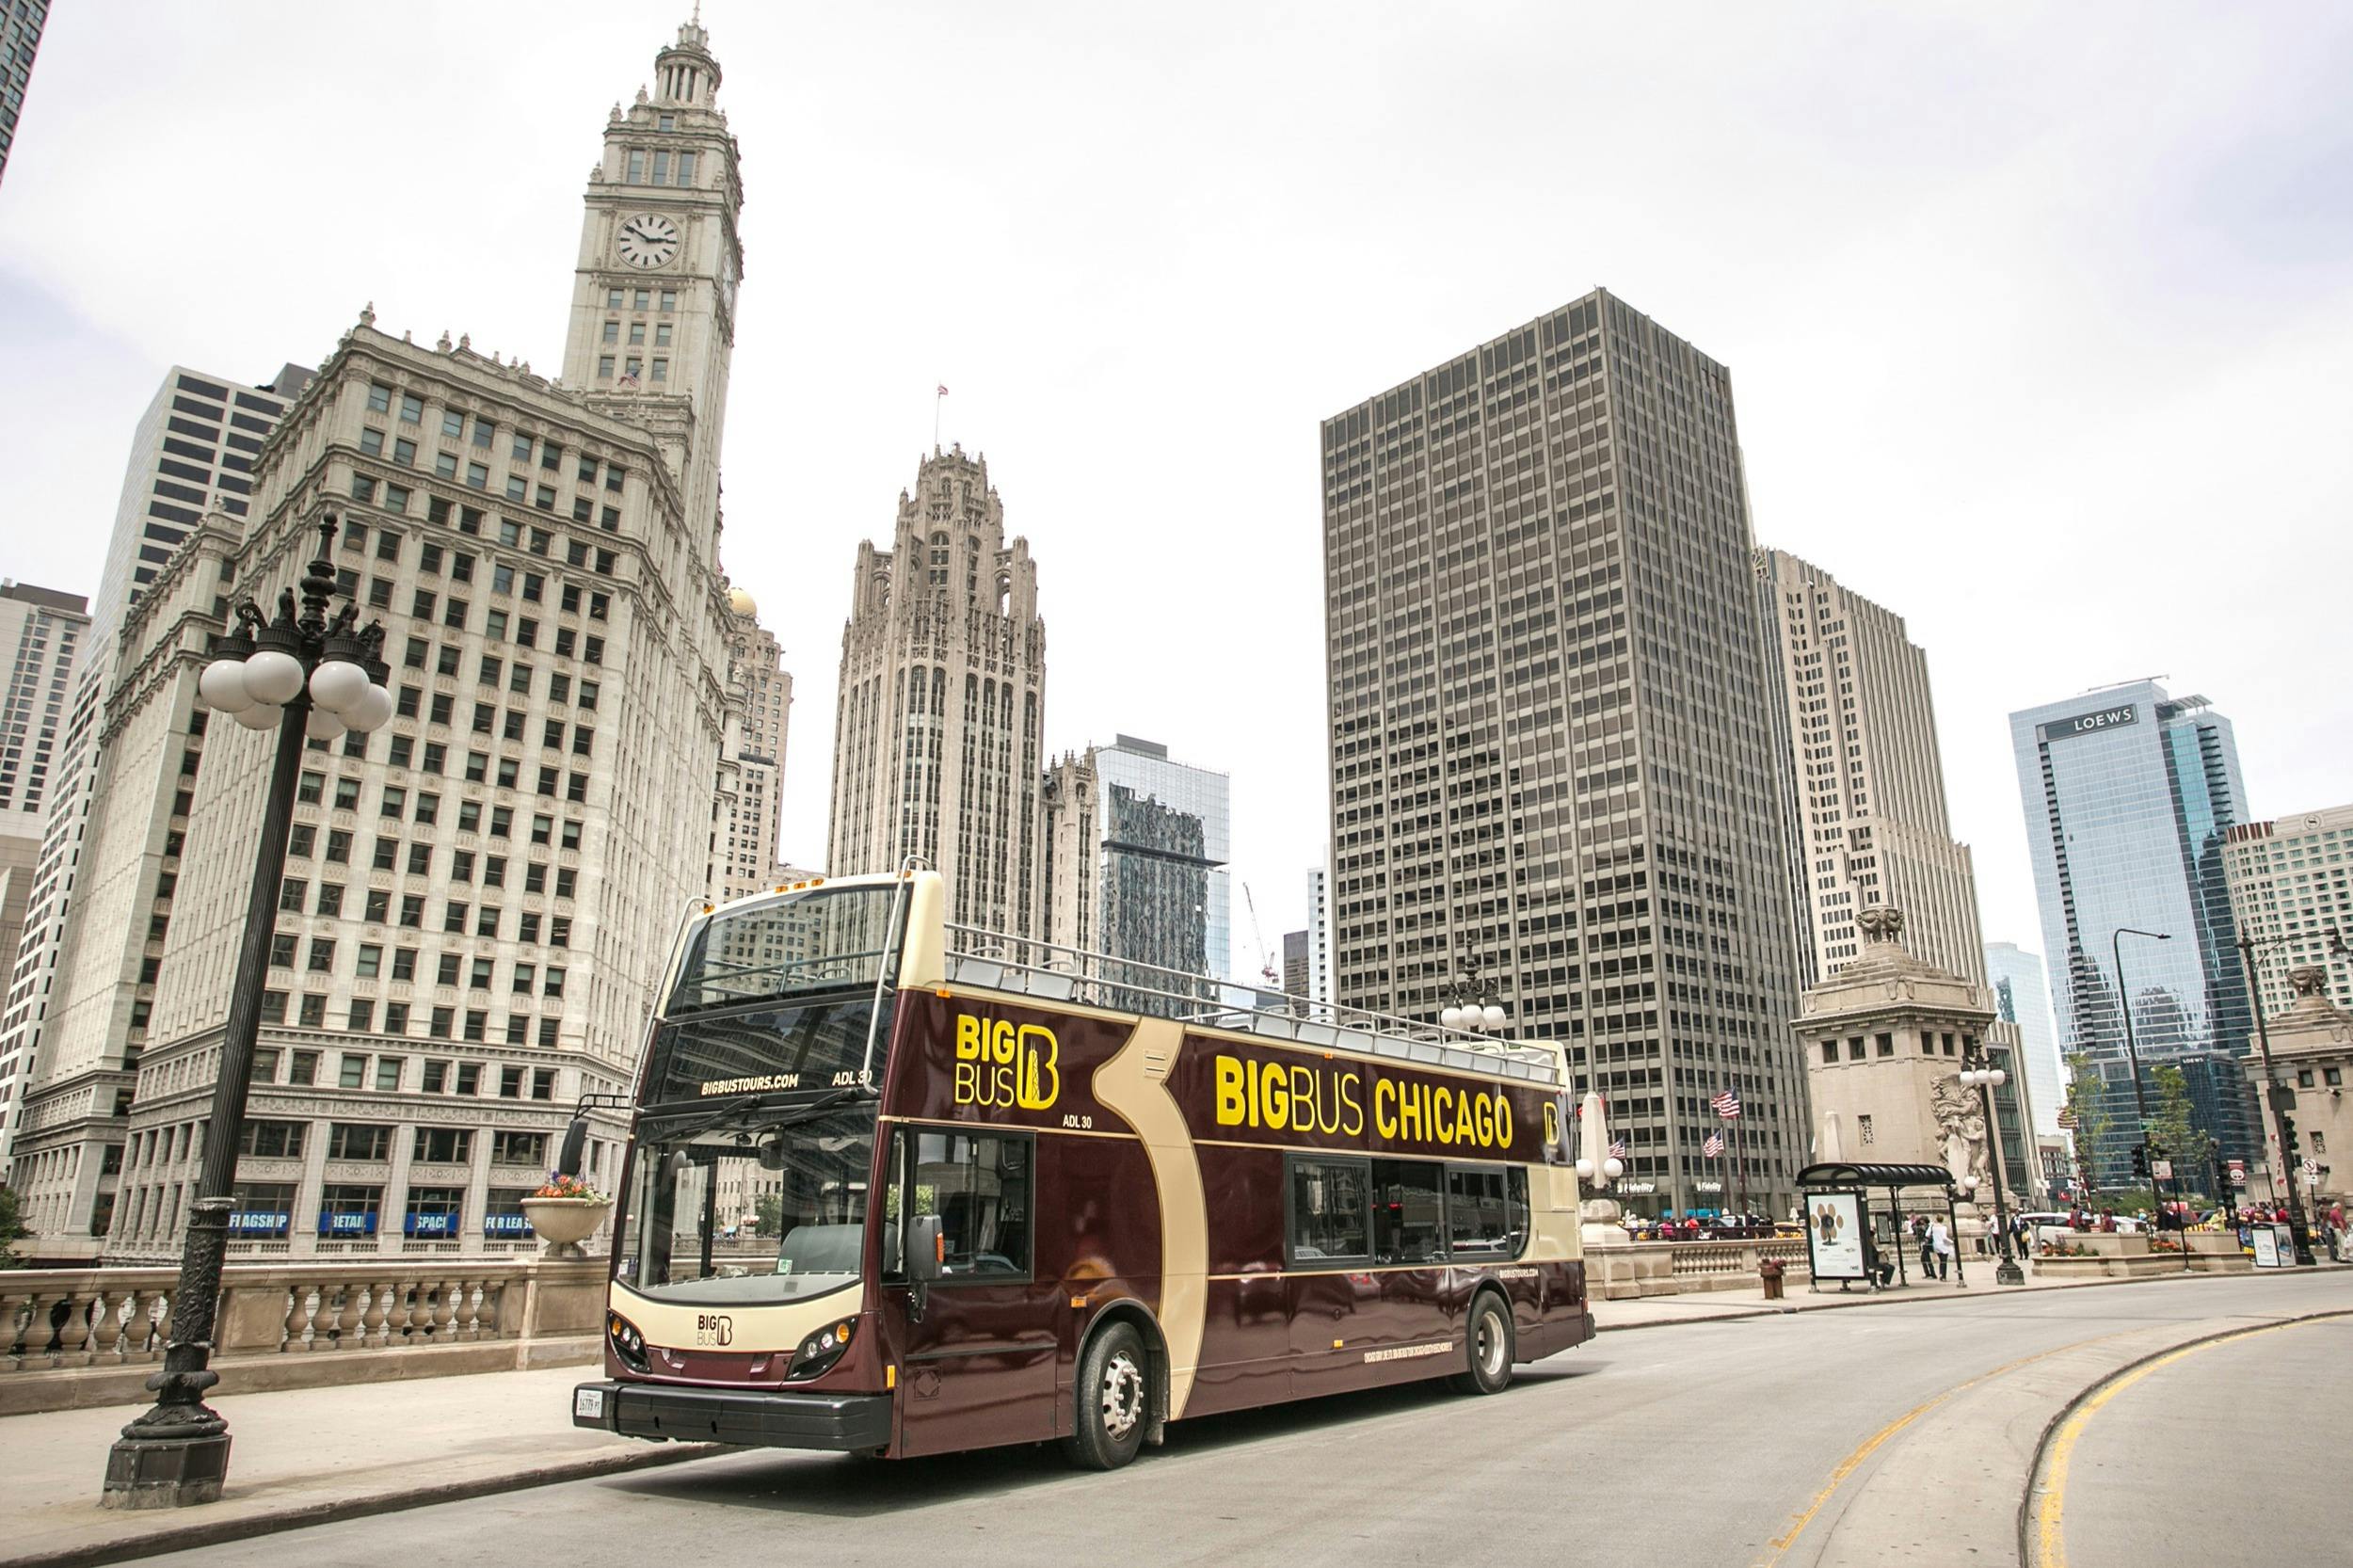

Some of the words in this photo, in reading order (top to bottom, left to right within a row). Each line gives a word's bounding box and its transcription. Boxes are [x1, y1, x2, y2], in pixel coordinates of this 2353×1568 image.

[2074, 709, 2132, 730] LOEWS
[956, 1014, 1016, 1064] BIG
[701, 1074, 799, 1096] BIGBUSTOURS.COM
[832, 1071, 856, 1086] ADL
[955, 1063, 1015, 1108] BUS
[1063, 1114, 1080, 1128] ADL
[1081, 1116, 1092, 1128] 30
[1375, 1078, 1513, 1149] CHICAGO
[1624, 1182, 1656, 1194] Fidelity
[229, 1214, 287, 1228] FLAGSHIP
[1498, 1268, 1539, 1279] BIGBUSTOURS.COM
[698, 1315, 716, 1330] BIG
[697, 1331, 716, 1346] BUS
